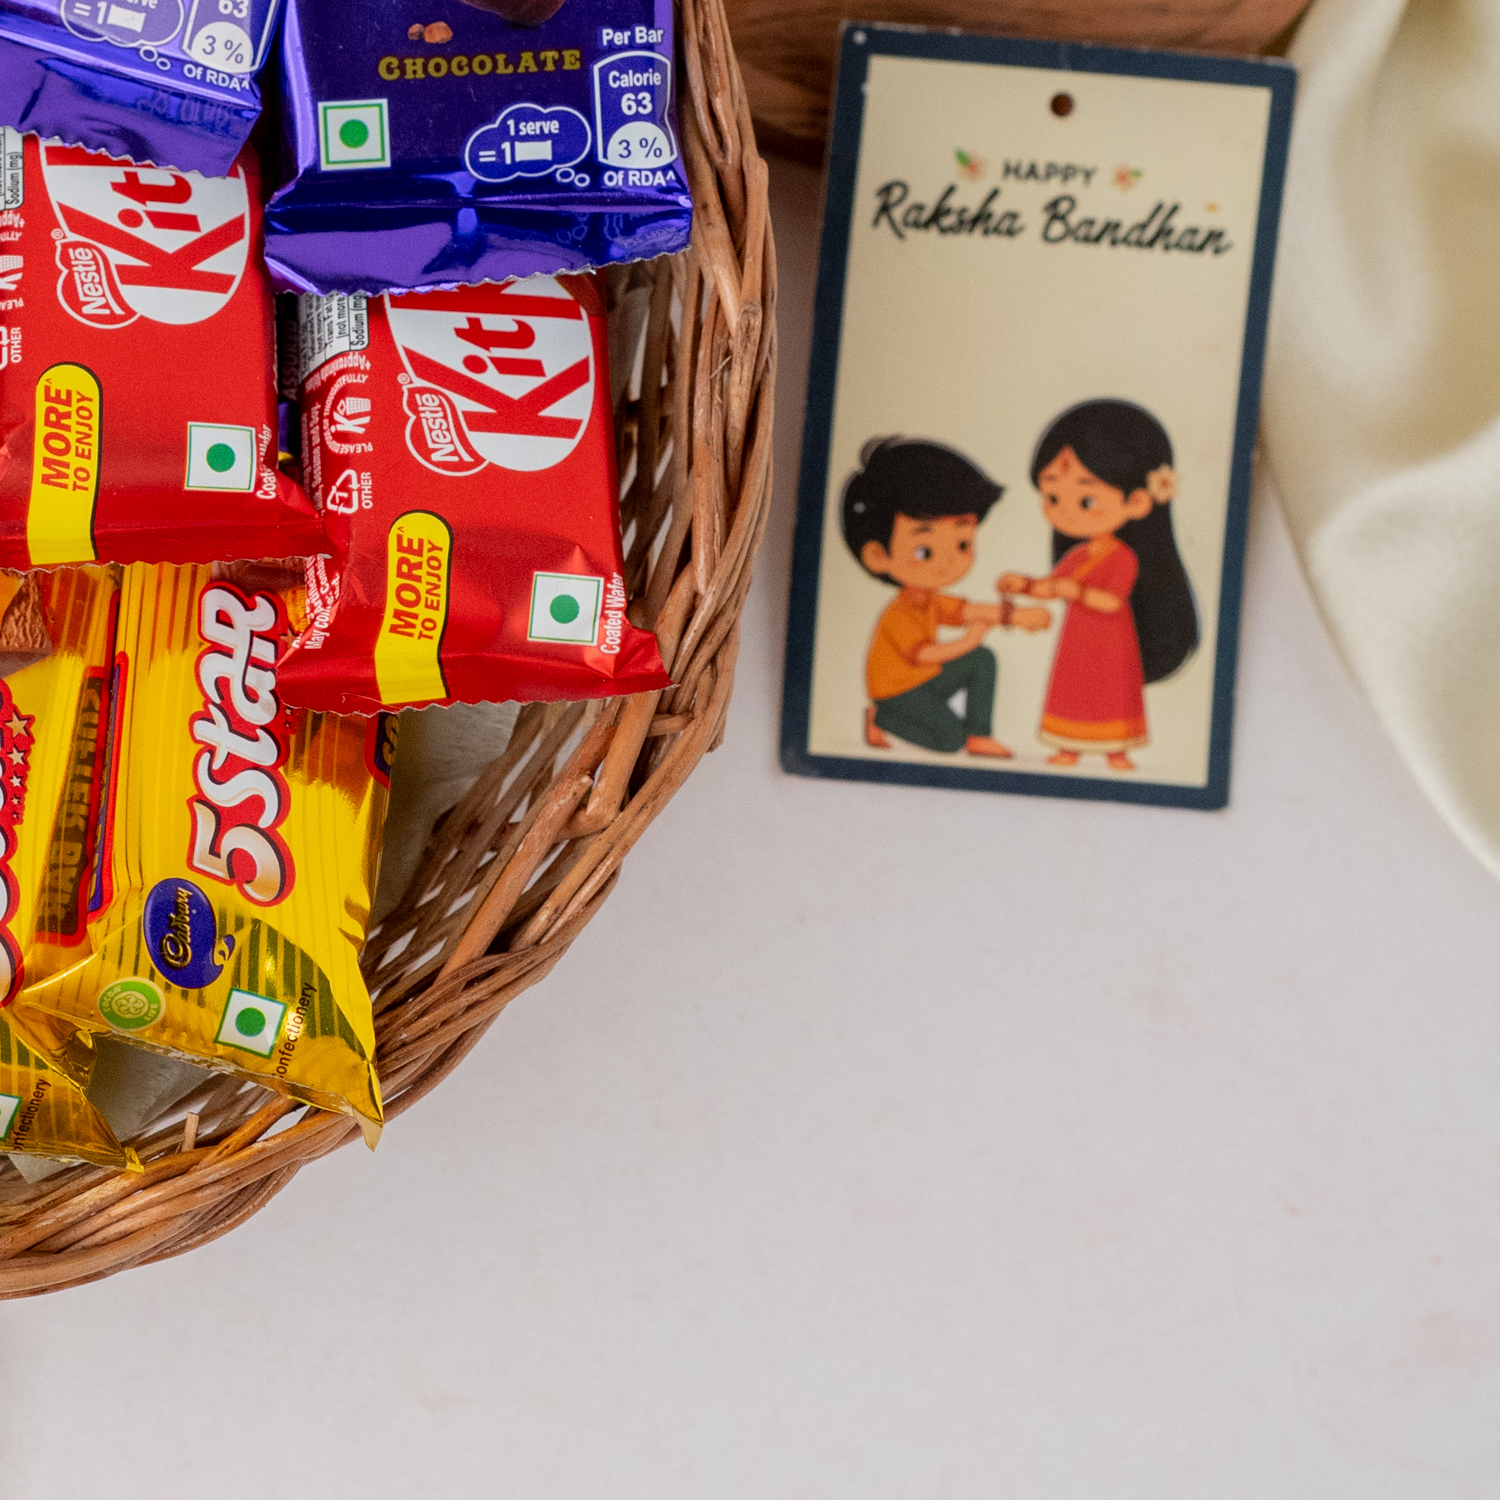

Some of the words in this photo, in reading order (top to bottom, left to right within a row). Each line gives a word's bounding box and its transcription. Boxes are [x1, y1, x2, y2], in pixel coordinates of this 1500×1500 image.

[602, 27, 630, 47] Per
[634, 26, 664, 45] Bar
[183, 64, 203, 82] Of
[378, 49, 582, 81] CHOCOLATE
[608, 69, 662, 88] Calorie
[620, 93, 653, 116] 63
[519, 118, 560, 136] serve
[5, 169, 21, 206] Sodium
[603, 169, 625, 187] Of
[1002, 158, 1098, 186] HAPPY
[46, 147, 247, 295] Kit
[872, 180, 1025, 242] Raksha
[1040, 195, 1233, 257] Bandhan
[10, 326, 22, 364] OTHER
[352, 313, 366, 346] Sodium
[73, 391, 95, 461] ENJOY
[72, 463, 91, 493] TO
[361, 472, 373, 509] OTHER
[421, 539, 445, 610] ENJOY
[604, 572, 624, 611] Wafer
[418, 611, 436, 641] TO
[599, 610, 622, 655] Coated
[160, 885, 193, 971] Cadbury
[12, 1078, 52, 1151] onfectionery
